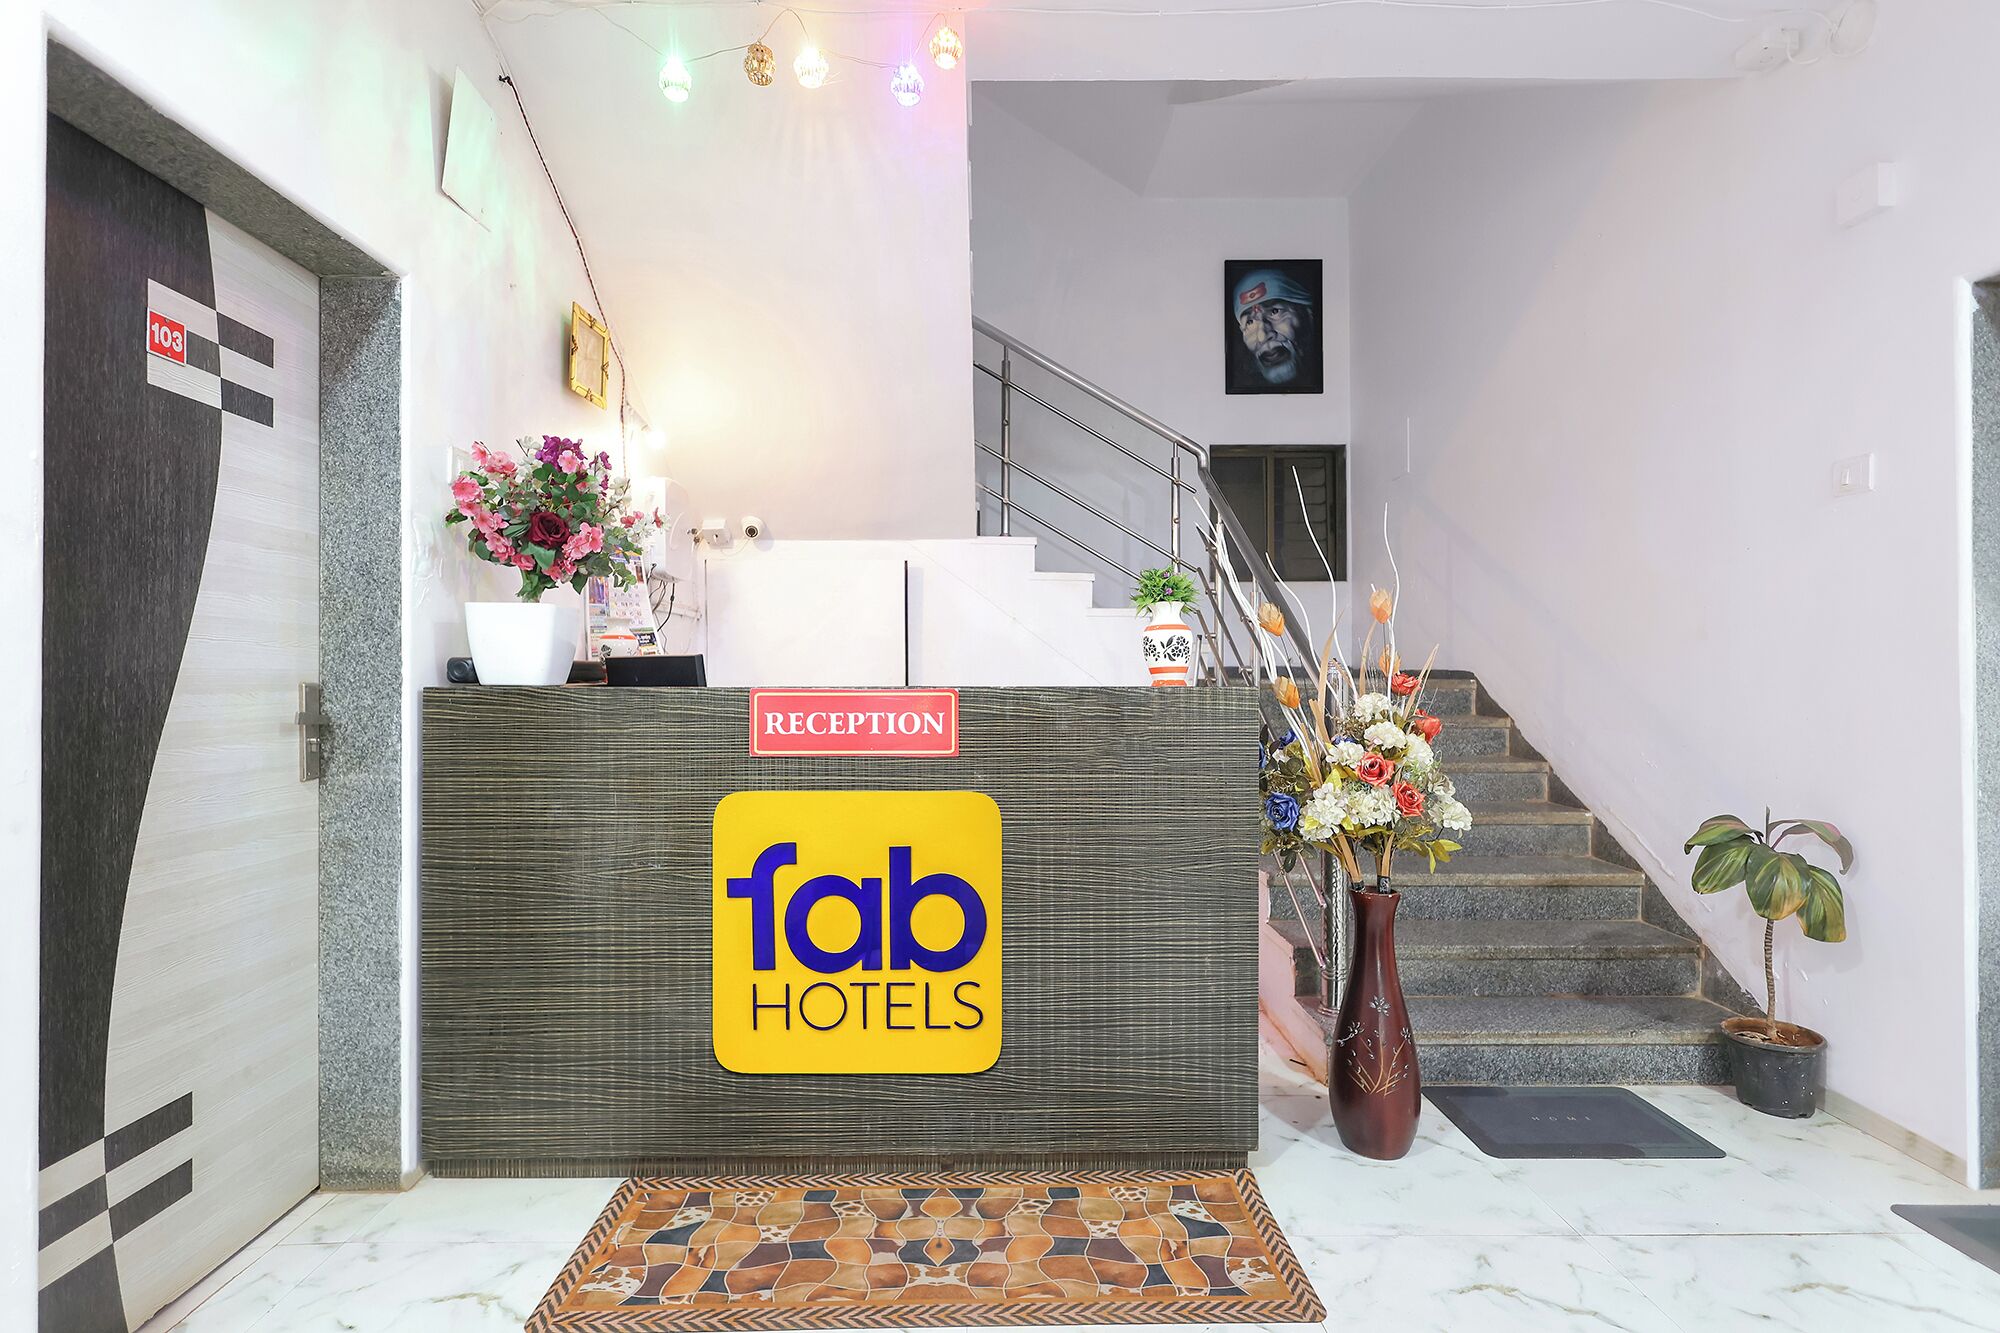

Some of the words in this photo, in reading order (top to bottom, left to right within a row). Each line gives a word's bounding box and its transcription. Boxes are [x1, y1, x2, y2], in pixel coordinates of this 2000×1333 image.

[151, 322, 183, 353] 103
[764, 711, 945, 735] RECEPTION
[726, 842, 987, 974] fab
[752, 981, 984, 1031] HOTELS
